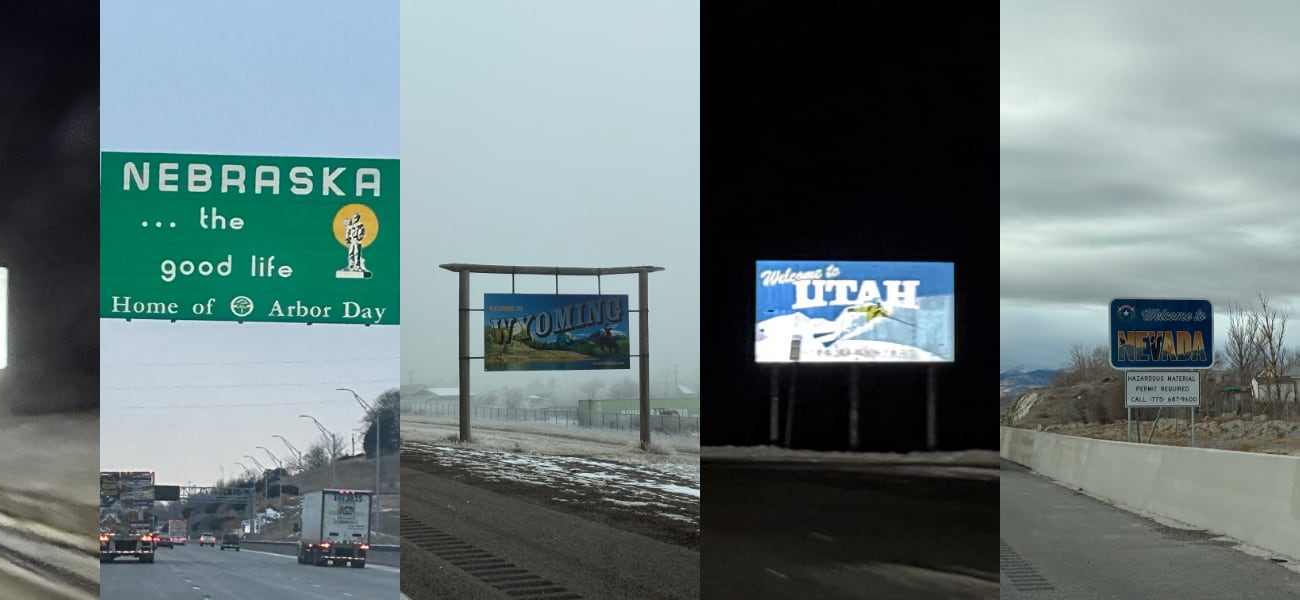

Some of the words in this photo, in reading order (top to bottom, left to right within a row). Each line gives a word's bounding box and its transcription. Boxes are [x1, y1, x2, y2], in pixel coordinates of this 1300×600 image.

[123, 161, 381, 197] NEBRASKA
[200, 206, 245, 230] the
[160, 254, 233, 282] good
[251, 255, 293, 278] life
[760, 267, 822, 286] Welcome
[825, 264, 841, 279] to
[791, 279, 921, 310] UTAH
[111, 296, 179, 314] Home
[192, 298, 216, 315] of
[268, 300, 331, 318] Arbor
[342, 301, 387, 324] Day
[490, 297, 624, 345] WYOMING
[1141, 307, 1193, 321] Welcome
[1193, 308, 1207, 321] to
[1117, 330, 1207, 362] NEVADA
